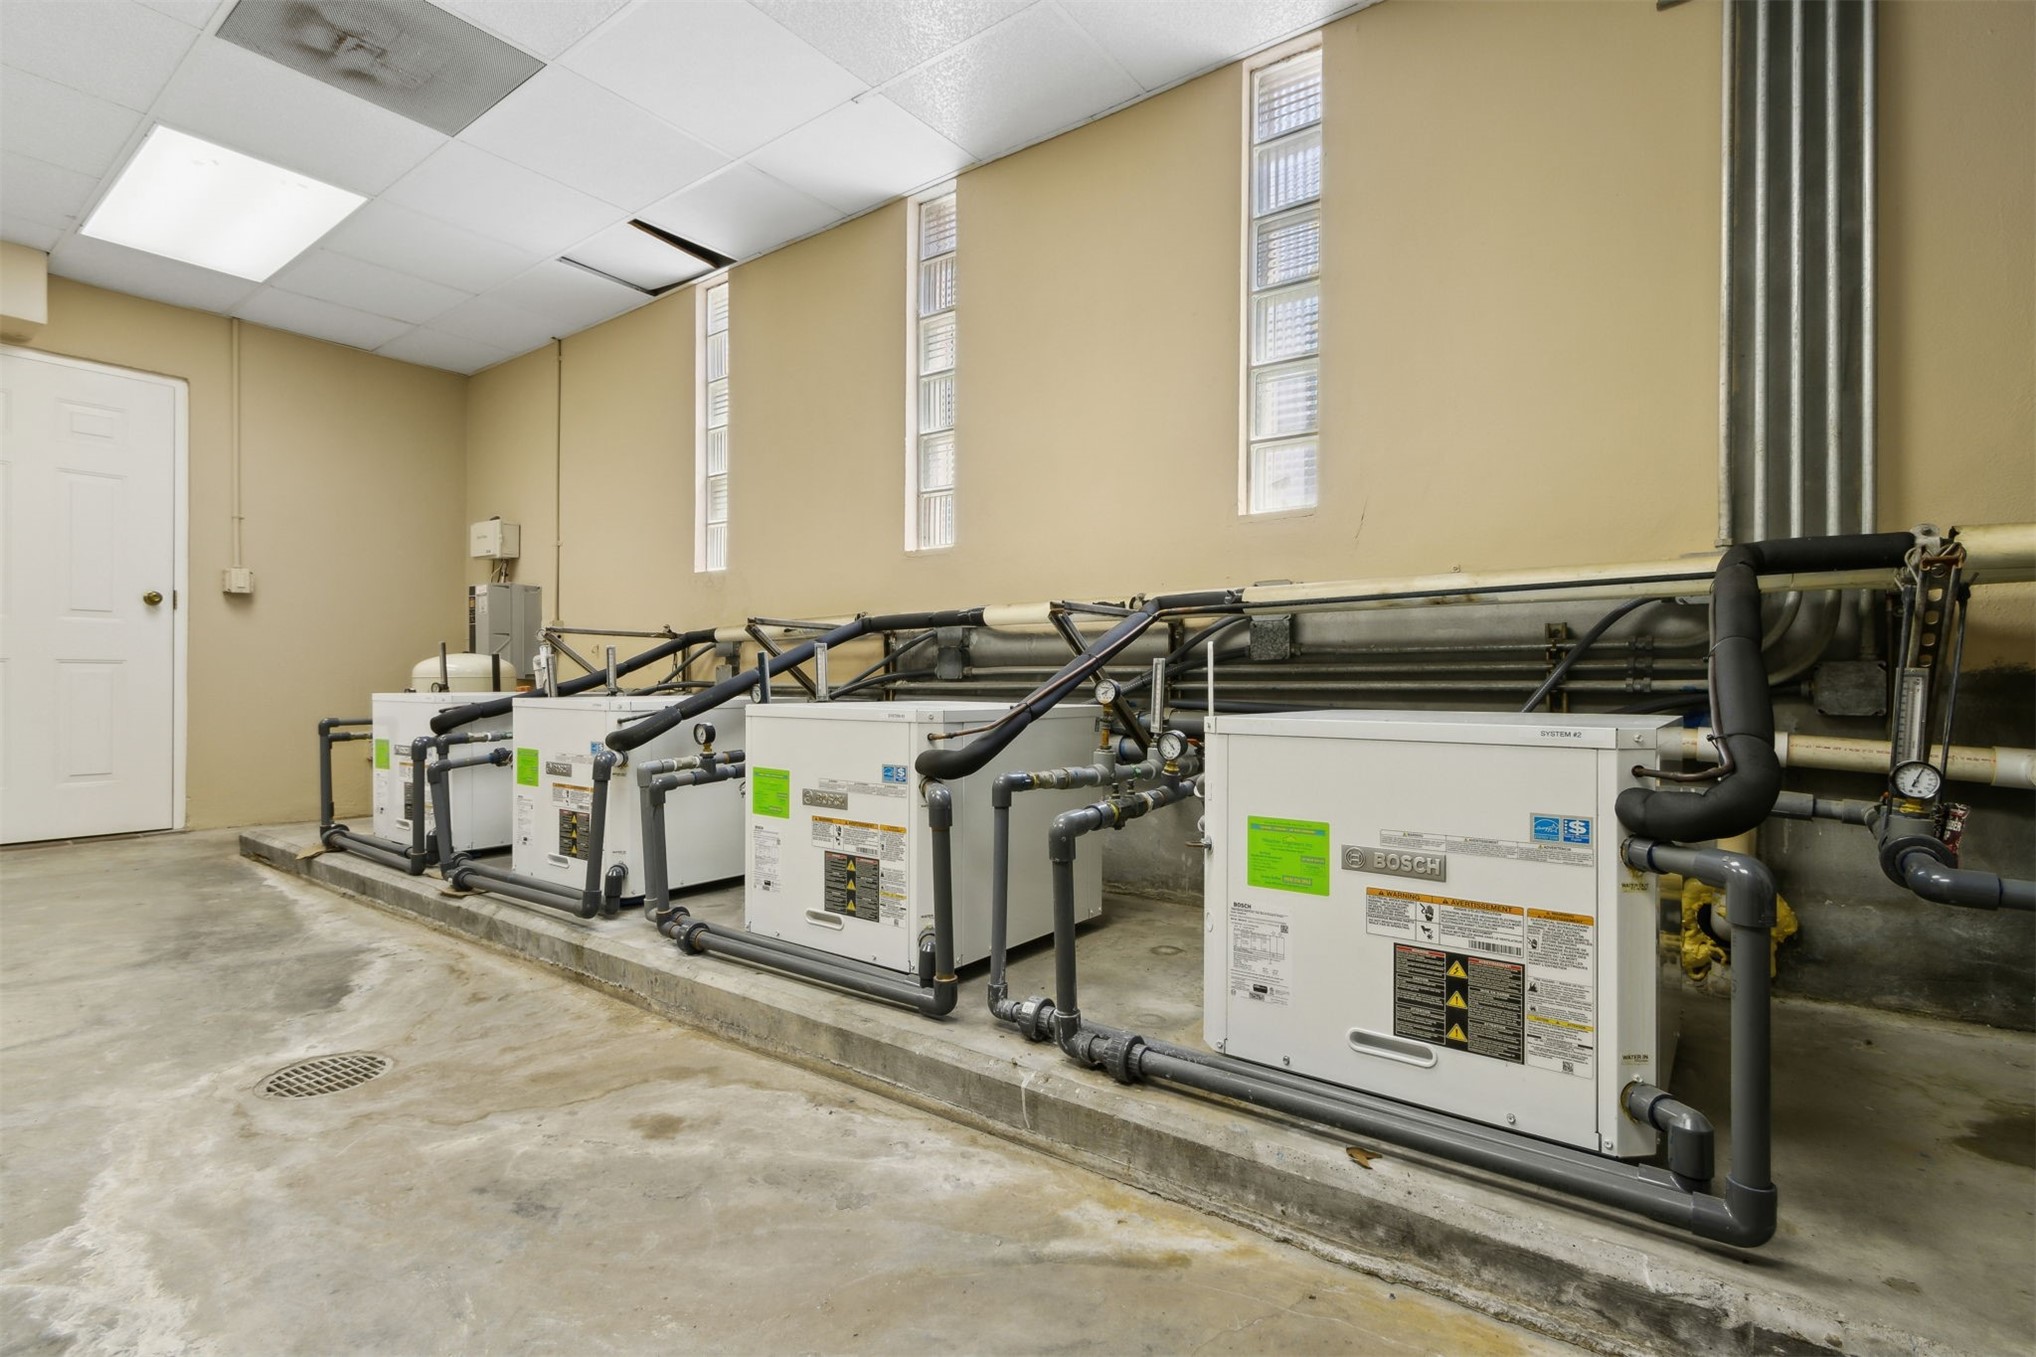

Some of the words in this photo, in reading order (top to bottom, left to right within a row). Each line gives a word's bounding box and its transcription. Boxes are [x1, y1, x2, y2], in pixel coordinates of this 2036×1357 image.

[1373, 852, 1441, 875] BOSCH
[1386, 890, 1421, 901] WARNING
[1233, 901, 1252, 909] BOSCH
[1451, 899, 1513, 913] AVERTISSEMENT
